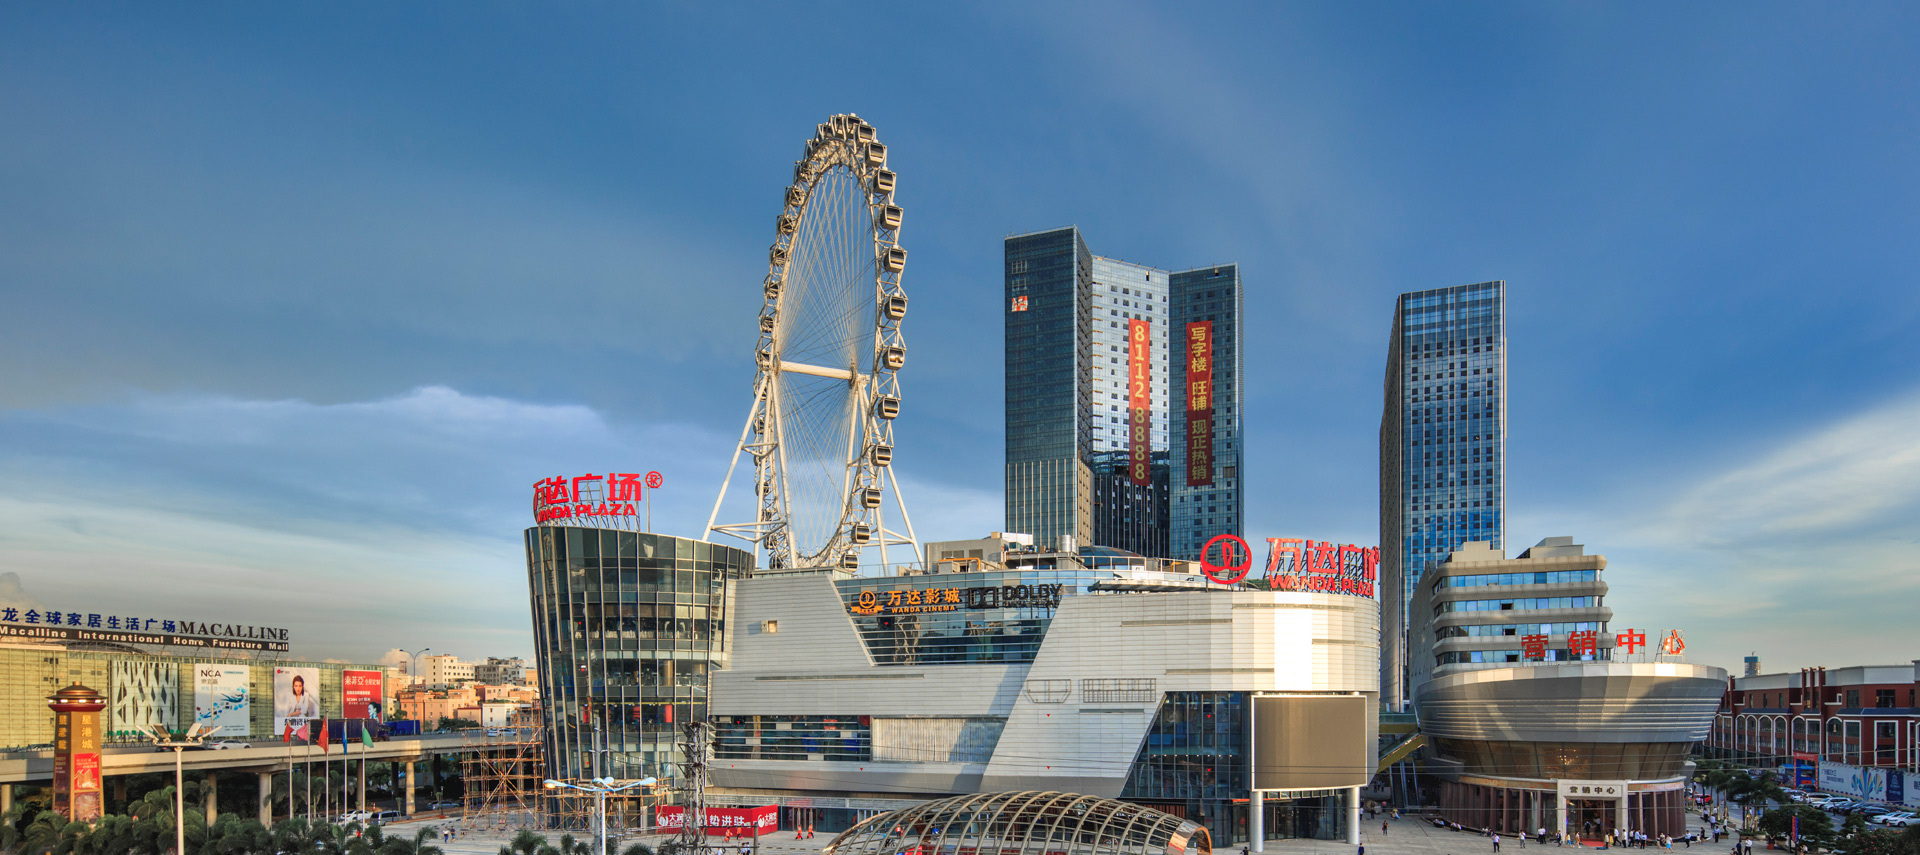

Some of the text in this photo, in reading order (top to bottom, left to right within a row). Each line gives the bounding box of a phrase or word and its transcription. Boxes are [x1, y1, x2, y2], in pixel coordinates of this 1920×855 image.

[1135, 325, 1145, 480] 8112 8888
[1191, 327, 1207, 480] 写字楼 旺铺 现正热销
[576, 504, 636, 517] PLAZA
[887, 587, 960, 606] 万达影城
[1003, 583, 1062, 600] DOLBY
[1269, 575, 1374, 597] WANDA PLAZA
[891, 605, 955, 614] WANDA CINEMA
[1, 607, 289, 641] 龙全球家居生活广场 MACALLINE
[0, 626, 289, 651] Macalline International Home Furniture Mall
[1521, 628, 1685, 659] 营销中心
[200, 670, 221, 678] NCA
[81, 715, 93, 749] 星港城
[1570, 786, 1615, 794] 营销中心
